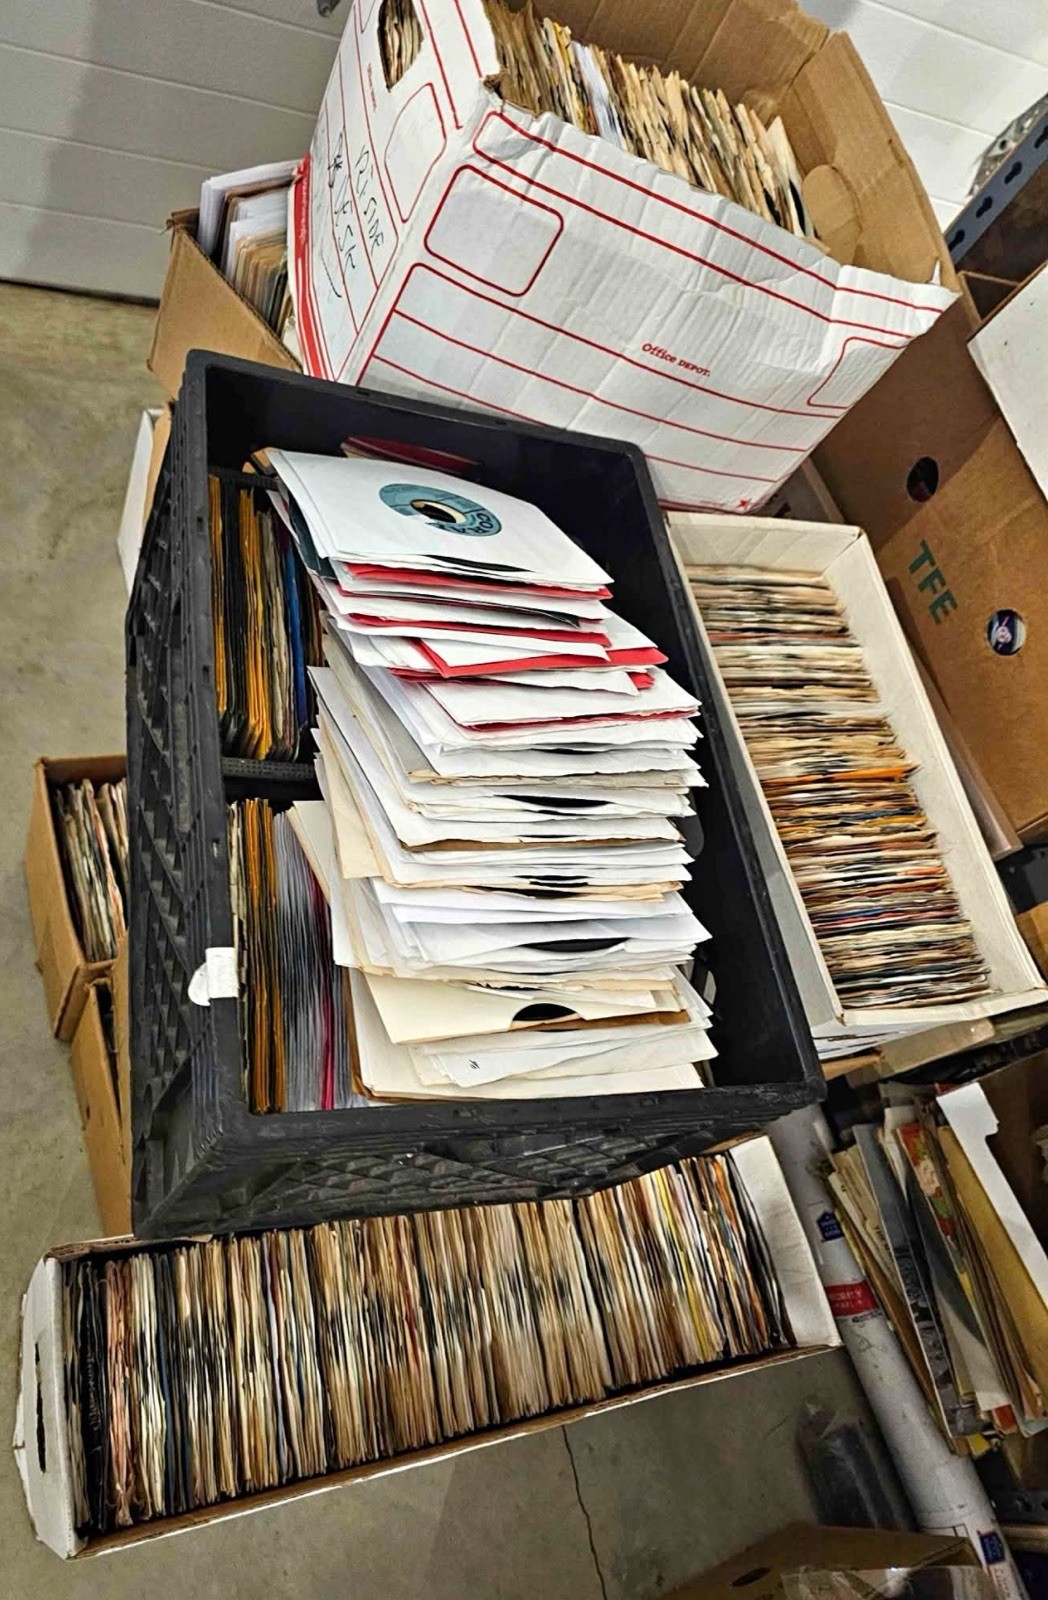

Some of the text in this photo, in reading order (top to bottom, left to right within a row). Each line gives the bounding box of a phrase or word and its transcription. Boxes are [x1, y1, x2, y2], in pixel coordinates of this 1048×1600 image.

[363, 197, 384, 257] SIDE
[641, 343, 677, 363] Office
[908, 539, 958, 626] TFE
